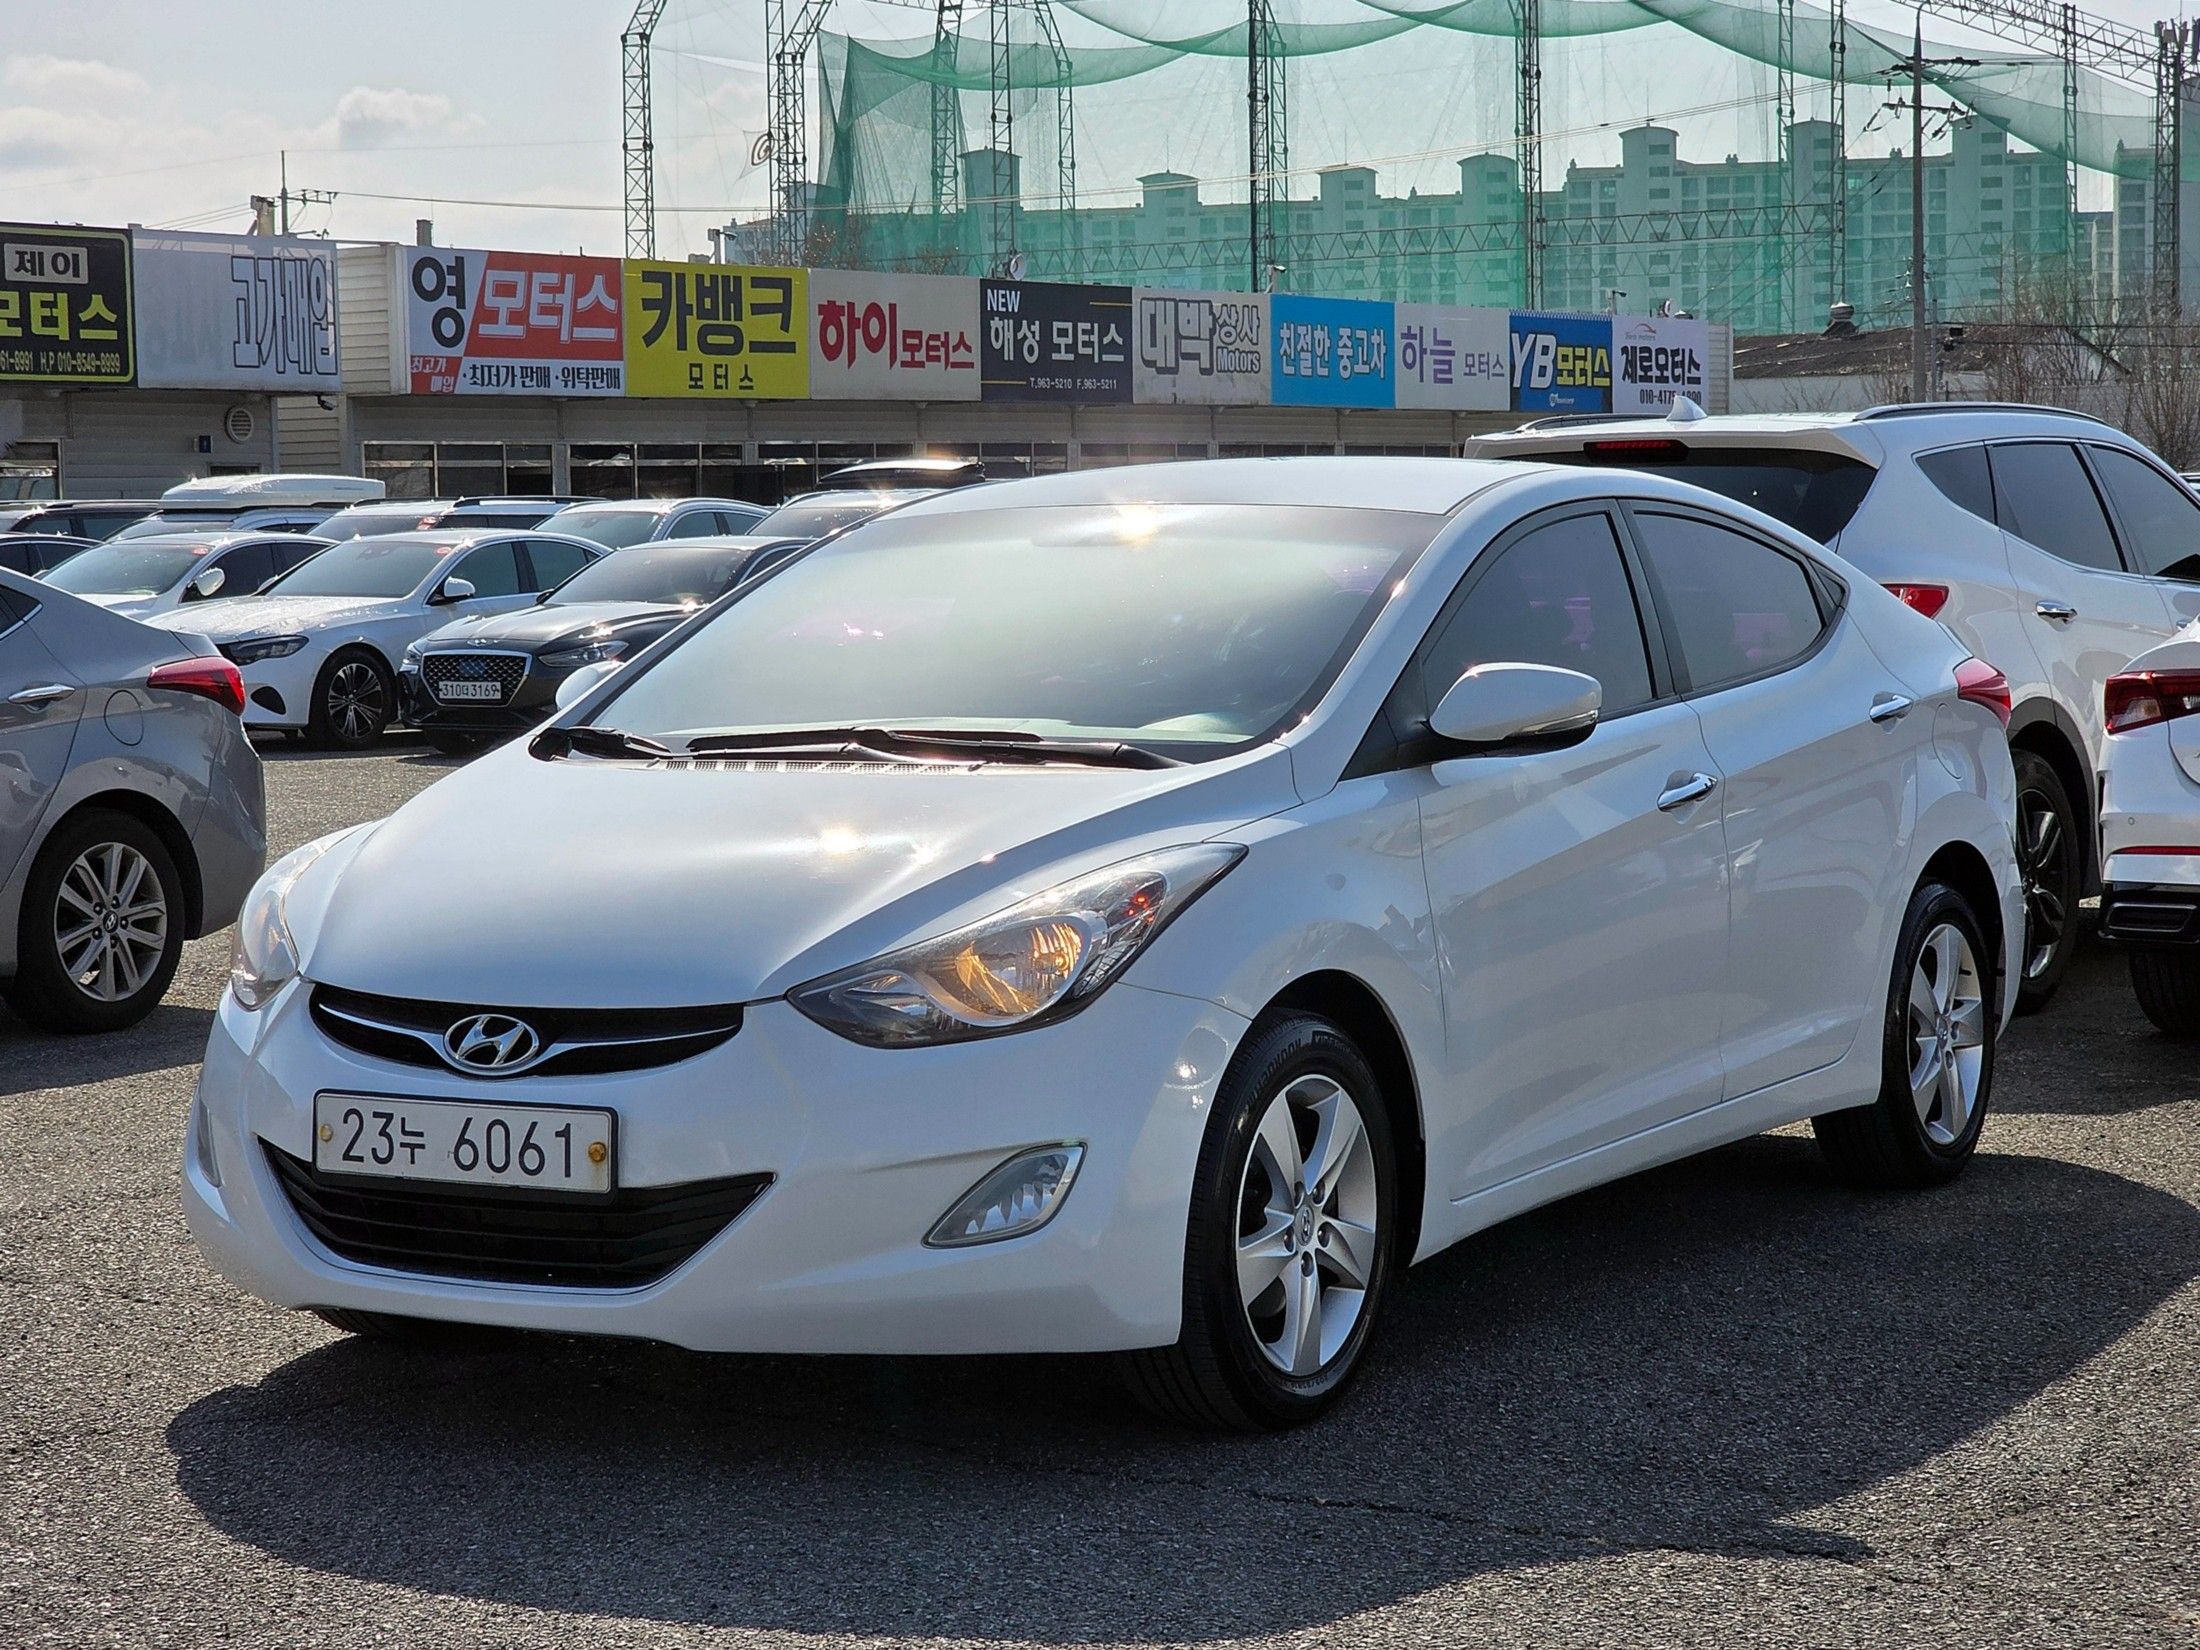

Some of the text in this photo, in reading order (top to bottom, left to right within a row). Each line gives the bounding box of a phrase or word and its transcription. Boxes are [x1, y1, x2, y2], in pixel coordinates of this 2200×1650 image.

[14, 250, 80, 278] 제이
[412, 256, 618, 348] 영 모터스
[641, 270, 797, 356] 카뱅크
[987, 289, 1020, 312] NEW
[990, 317, 1125, 364] 해성 모터스
[1140, 297, 1260, 376] 대박 상사
[1216, 346, 1260, 373] Motors
[1280, 322, 1387, 380] 친절한 중고차
[1400, 325, 1505, 385] 하늘 모터스
[411, 356, 447, 373] 최고가
[430, 375, 455, 393] 매입
[688, 363, 754, 391] 모터스
[341, 1108, 573, 1179] 23누 6061
